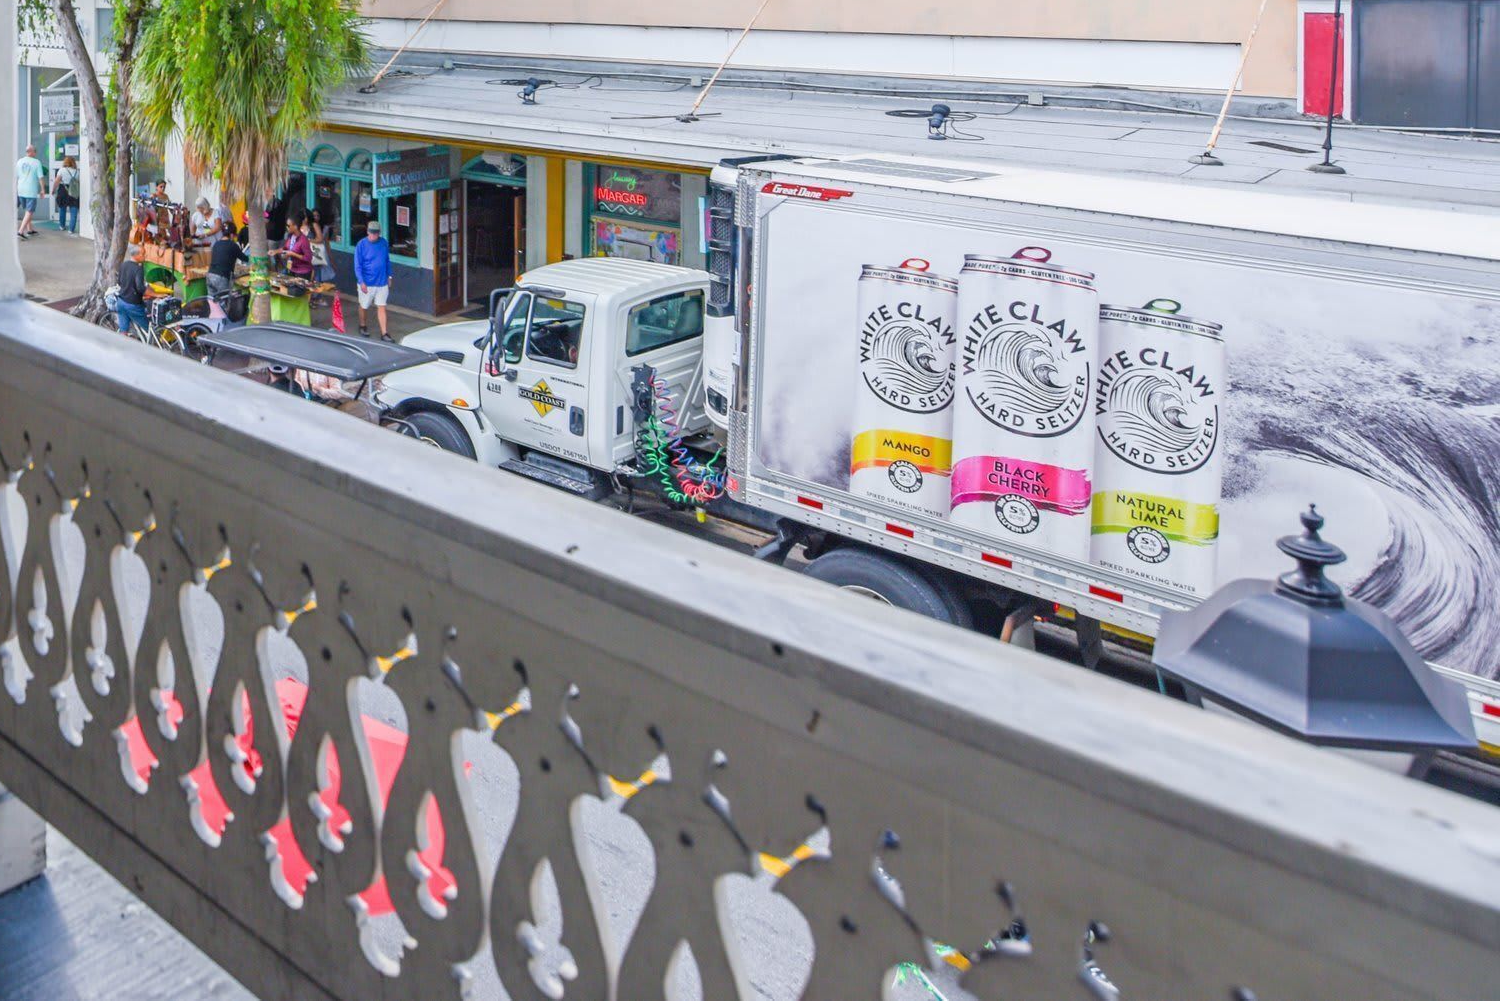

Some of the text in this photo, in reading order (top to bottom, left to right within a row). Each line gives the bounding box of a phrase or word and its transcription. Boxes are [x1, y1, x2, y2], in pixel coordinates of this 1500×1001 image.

[772, 184, 822, 199] Great Dane
[860, 302, 956, 363] WHITE CLAW
[963, 301, 1086, 375] WHITE CLAW
[871, 362, 956, 407] HARD SELTZER
[1096, 348, 1214, 415] WHITE CLAW
[519, 389, 565, 408] GOLD COAST
[976, 375, 1086, 430] HARD SELTZER
[539, 441, 561, 453] USDOT
[882, 438, 931, 458] MANGO
[1107, 417, 1214, 468] HARD SELTZER
[988, 473, 1050, 498] CHERRY
[994, 461, 1045, 484] BLACK
[866, 491, 943, 518] SPIKED SPARKLING WATER
[1009, 505, 1026, 516] 5%
[1116, 494, 1185, 520] NATURAL
[1131, 509, 1169, 528] LIME
[1099, 560, 1196, 592] SPIKED SPARKLING WATER
